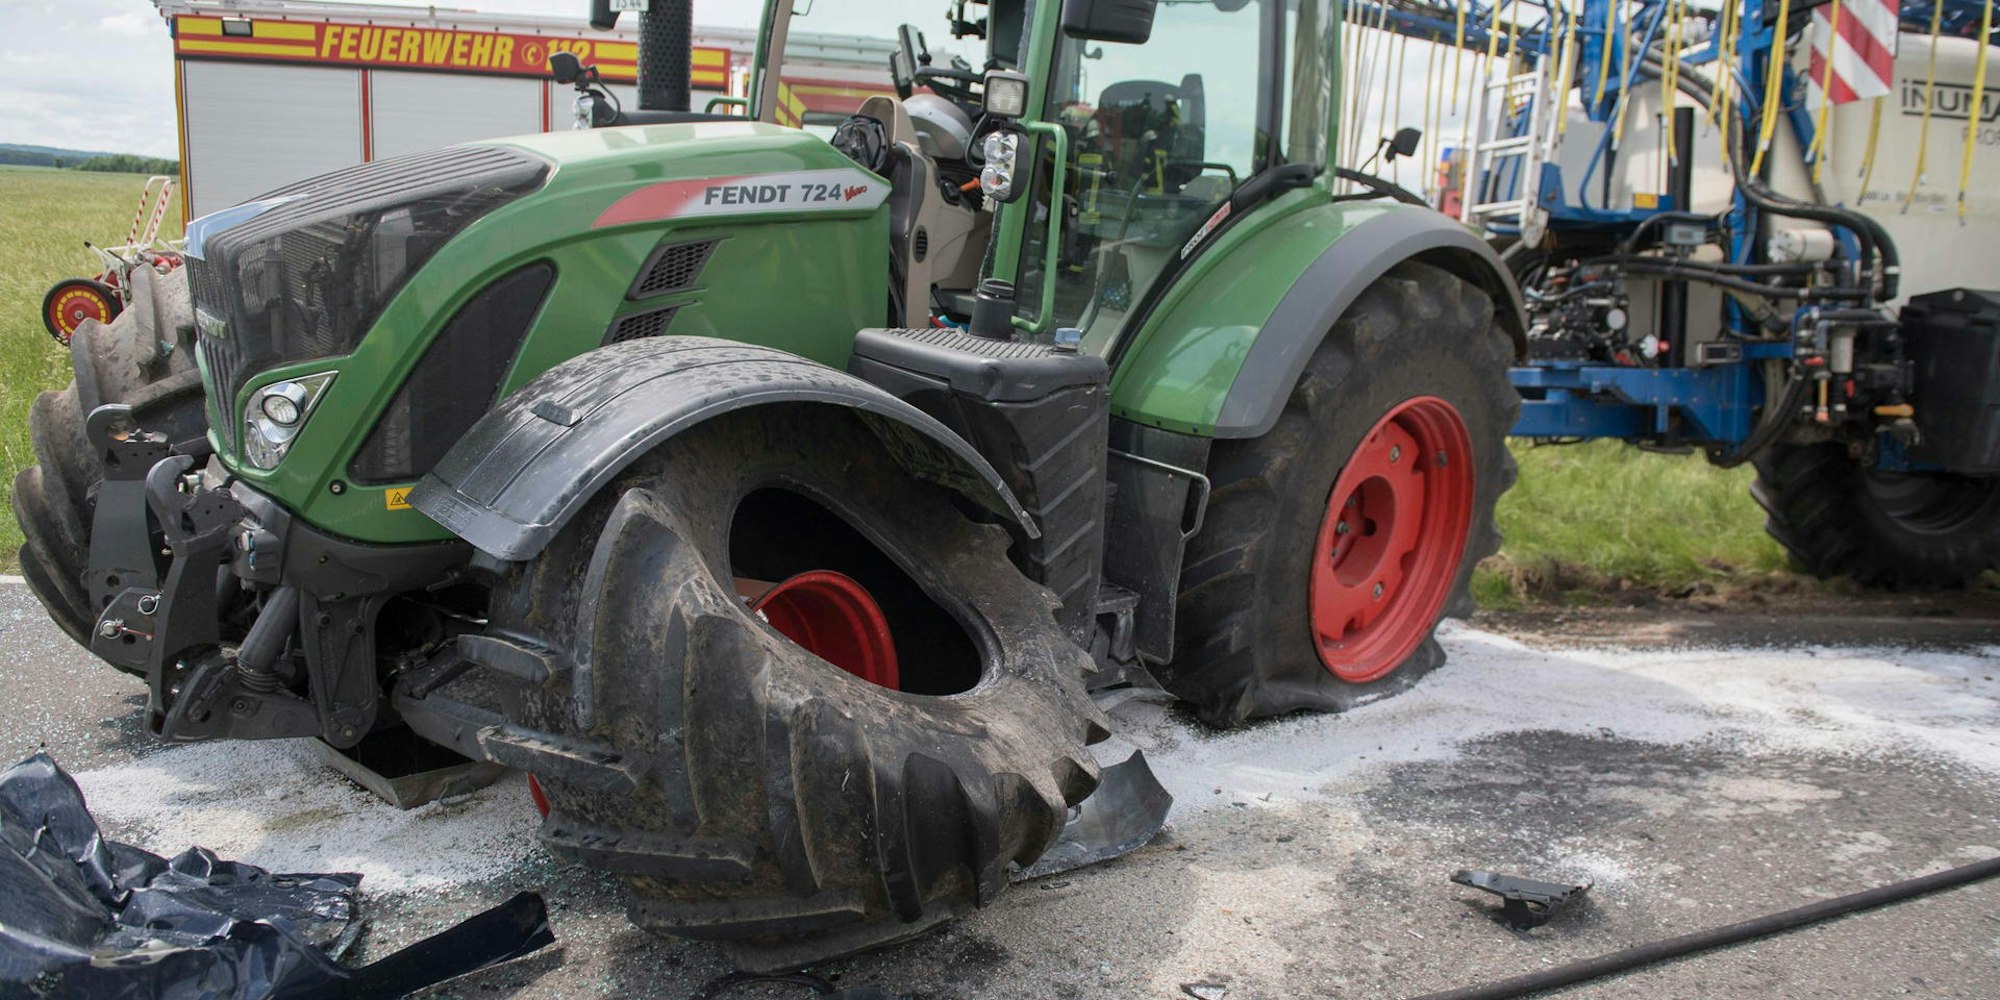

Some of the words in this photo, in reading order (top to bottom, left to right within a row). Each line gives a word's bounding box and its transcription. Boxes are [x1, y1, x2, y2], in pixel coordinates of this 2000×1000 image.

[321, 25, 514, 68] FEUERWEHR
[704, 185, 791, 205] FENDT
[800, 184, 841, 202] 724
